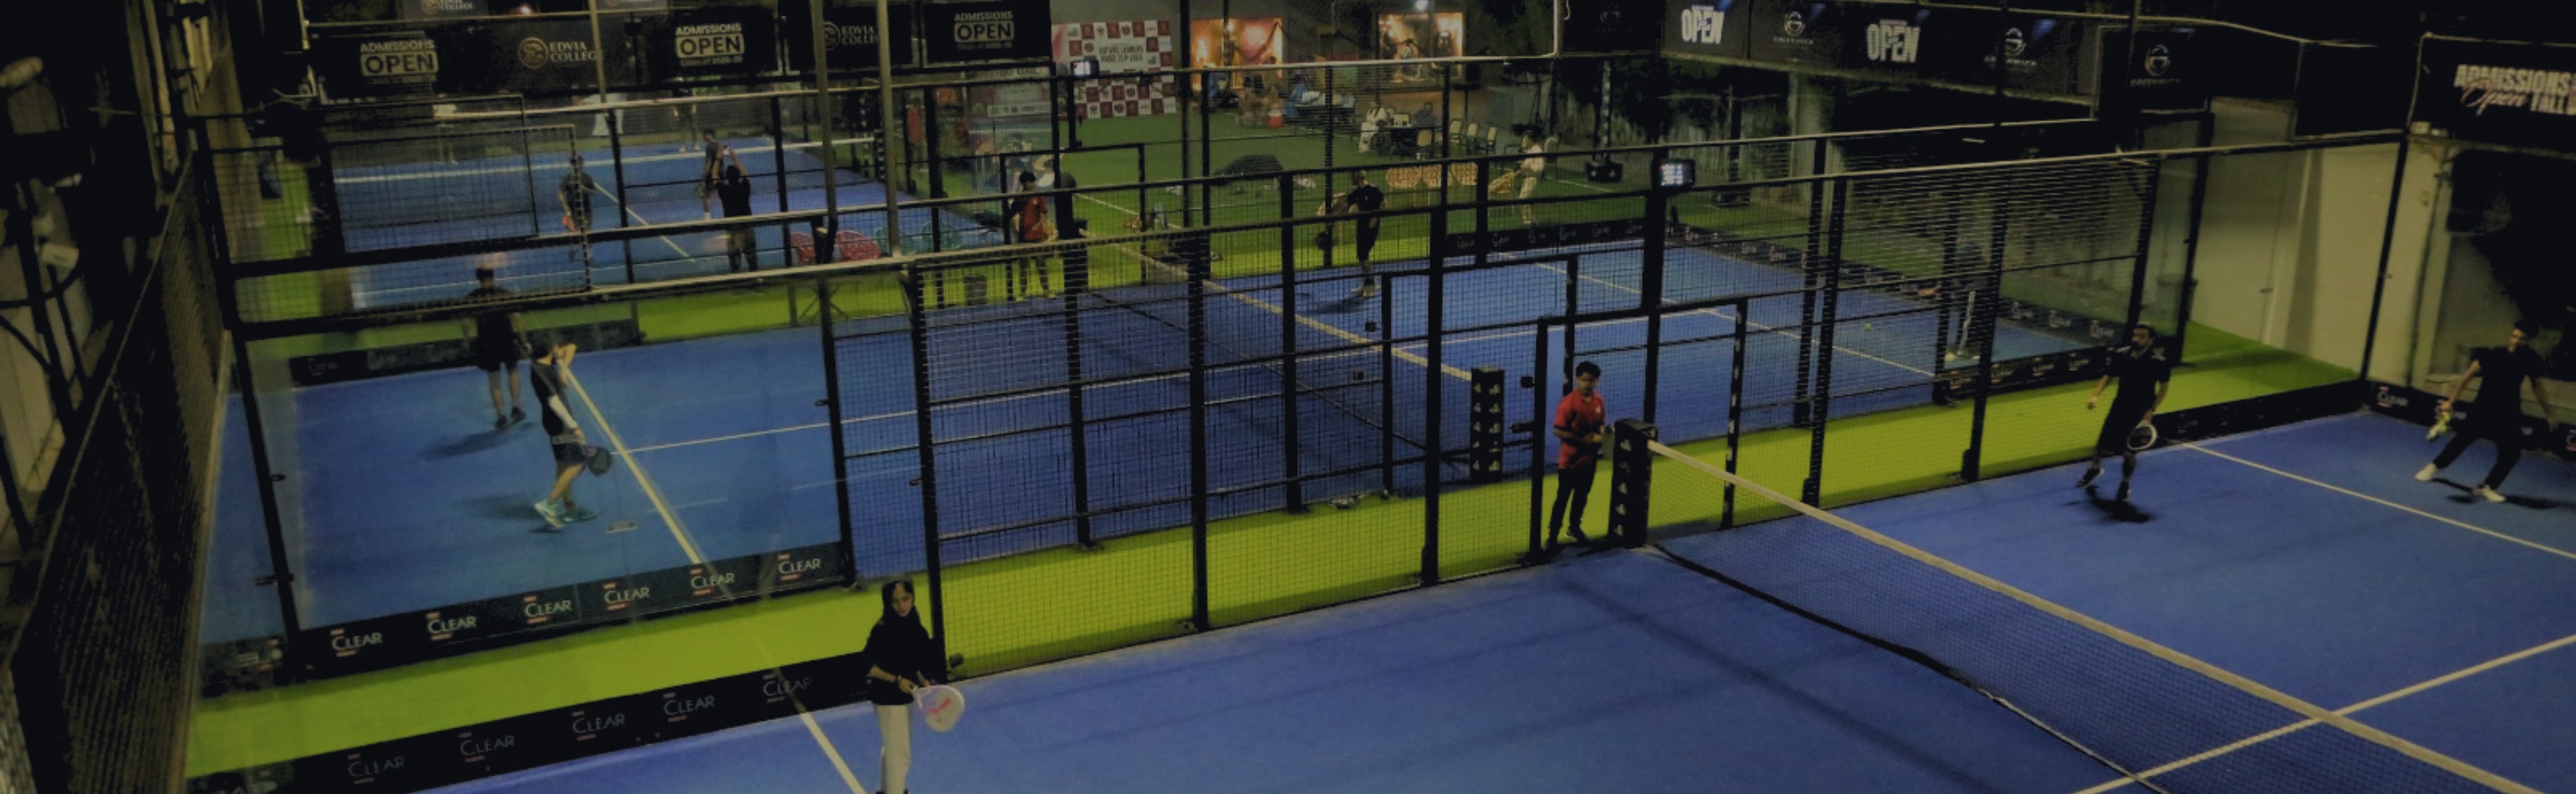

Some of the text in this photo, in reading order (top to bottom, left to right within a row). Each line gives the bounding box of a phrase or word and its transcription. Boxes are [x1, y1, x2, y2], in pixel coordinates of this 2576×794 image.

[954, 11, 1013, 22] ADMISSIONS
[675, 23, 742, 36] ADMISSIONS
[958, 23, 1011, 40] OPEN
[1681, 9, 1725, 44] OPEN
[360, 39, 435, 53] ADMISSIONS
[680, 36, 741, 55] OPEN
[1866, 24, 1920, 63] OPEN
[365, 52, 434, 73] OPEN
[549, 51, 598, 63] COLLEG
[2454, 64, 2572, 97] ADMISSIONS
[2460, 78, 2528, 116] Open
[779, 557, 821, 574] CLEAR
[691, 572, 735, 590] CLEAR
[604, 587, 650, 604] CLEAR
[524, 600, 572, 618] CLEAR
[426, 616, 477, 634] CLEAR
[331, 632, 384, 651] CLEAR
[763, 678, 812, 697] CLEAR
[663, 695, 715, 716] CLEAR
[572, 713, 625, 733] CLEAR
[460, 735, 515, 756] CLEAR
[347, 756, 405, 777] CLEAR
